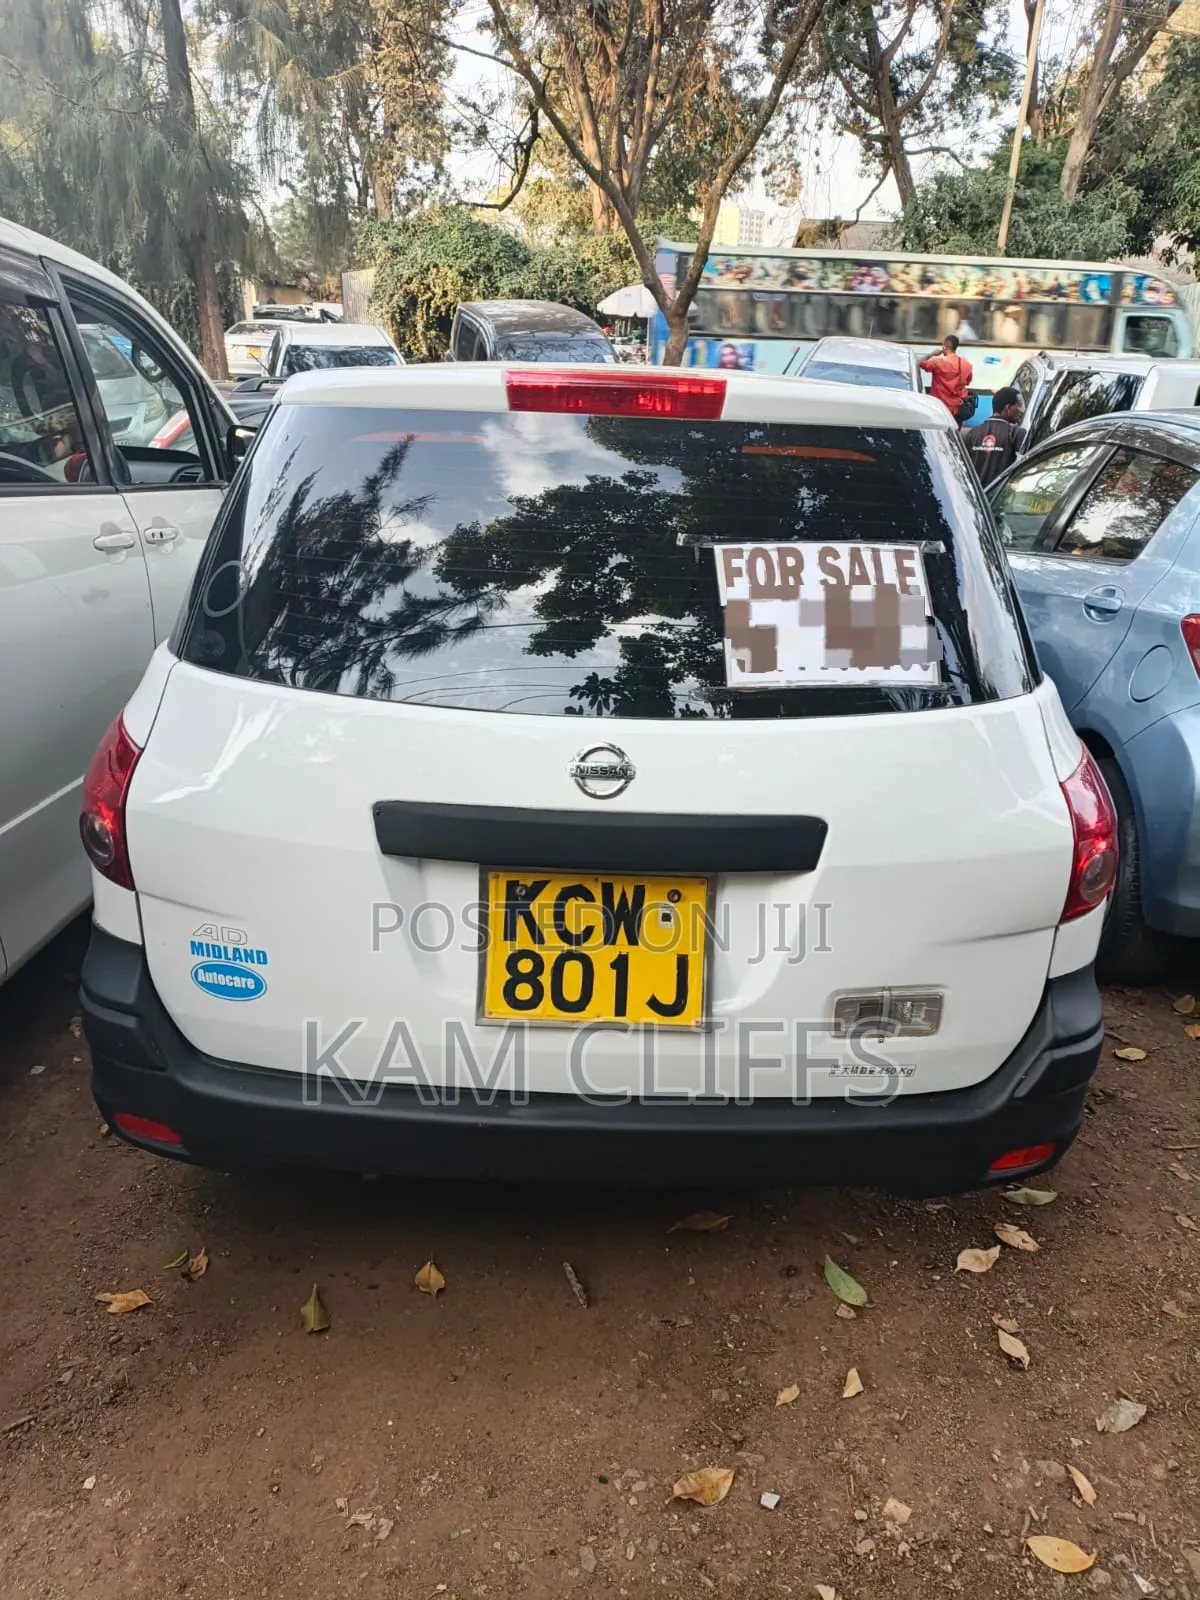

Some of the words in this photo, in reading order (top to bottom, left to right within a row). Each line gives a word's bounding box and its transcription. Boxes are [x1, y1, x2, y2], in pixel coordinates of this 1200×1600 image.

[722, 546, 804, 587] FOR
[818, 546, 915, 594] SALE
[575, 764, 628, 777] NISSAN
[503, 879, 646, 946] KCW
[192, 923, 247, 945] AD
[189, 940, 268, 965] MIDLAND
[197, 968, 255, 989] Autocare
